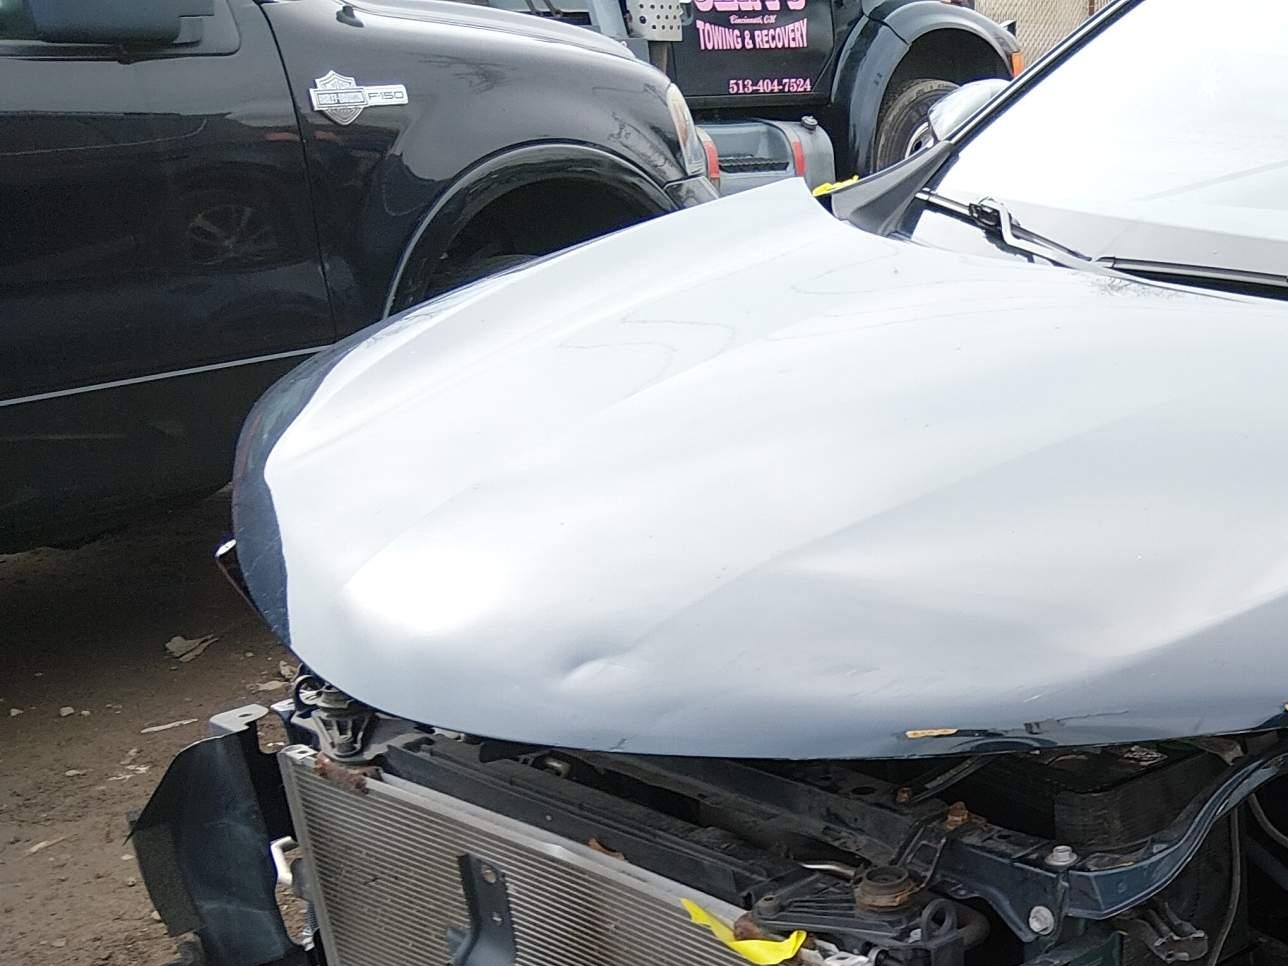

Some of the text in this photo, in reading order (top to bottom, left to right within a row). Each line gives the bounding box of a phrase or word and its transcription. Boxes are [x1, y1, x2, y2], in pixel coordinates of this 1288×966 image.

[695, 18, 808, 50] TOWING & RECOVERY
[728, 77, 812, 95] 513-404-7524
